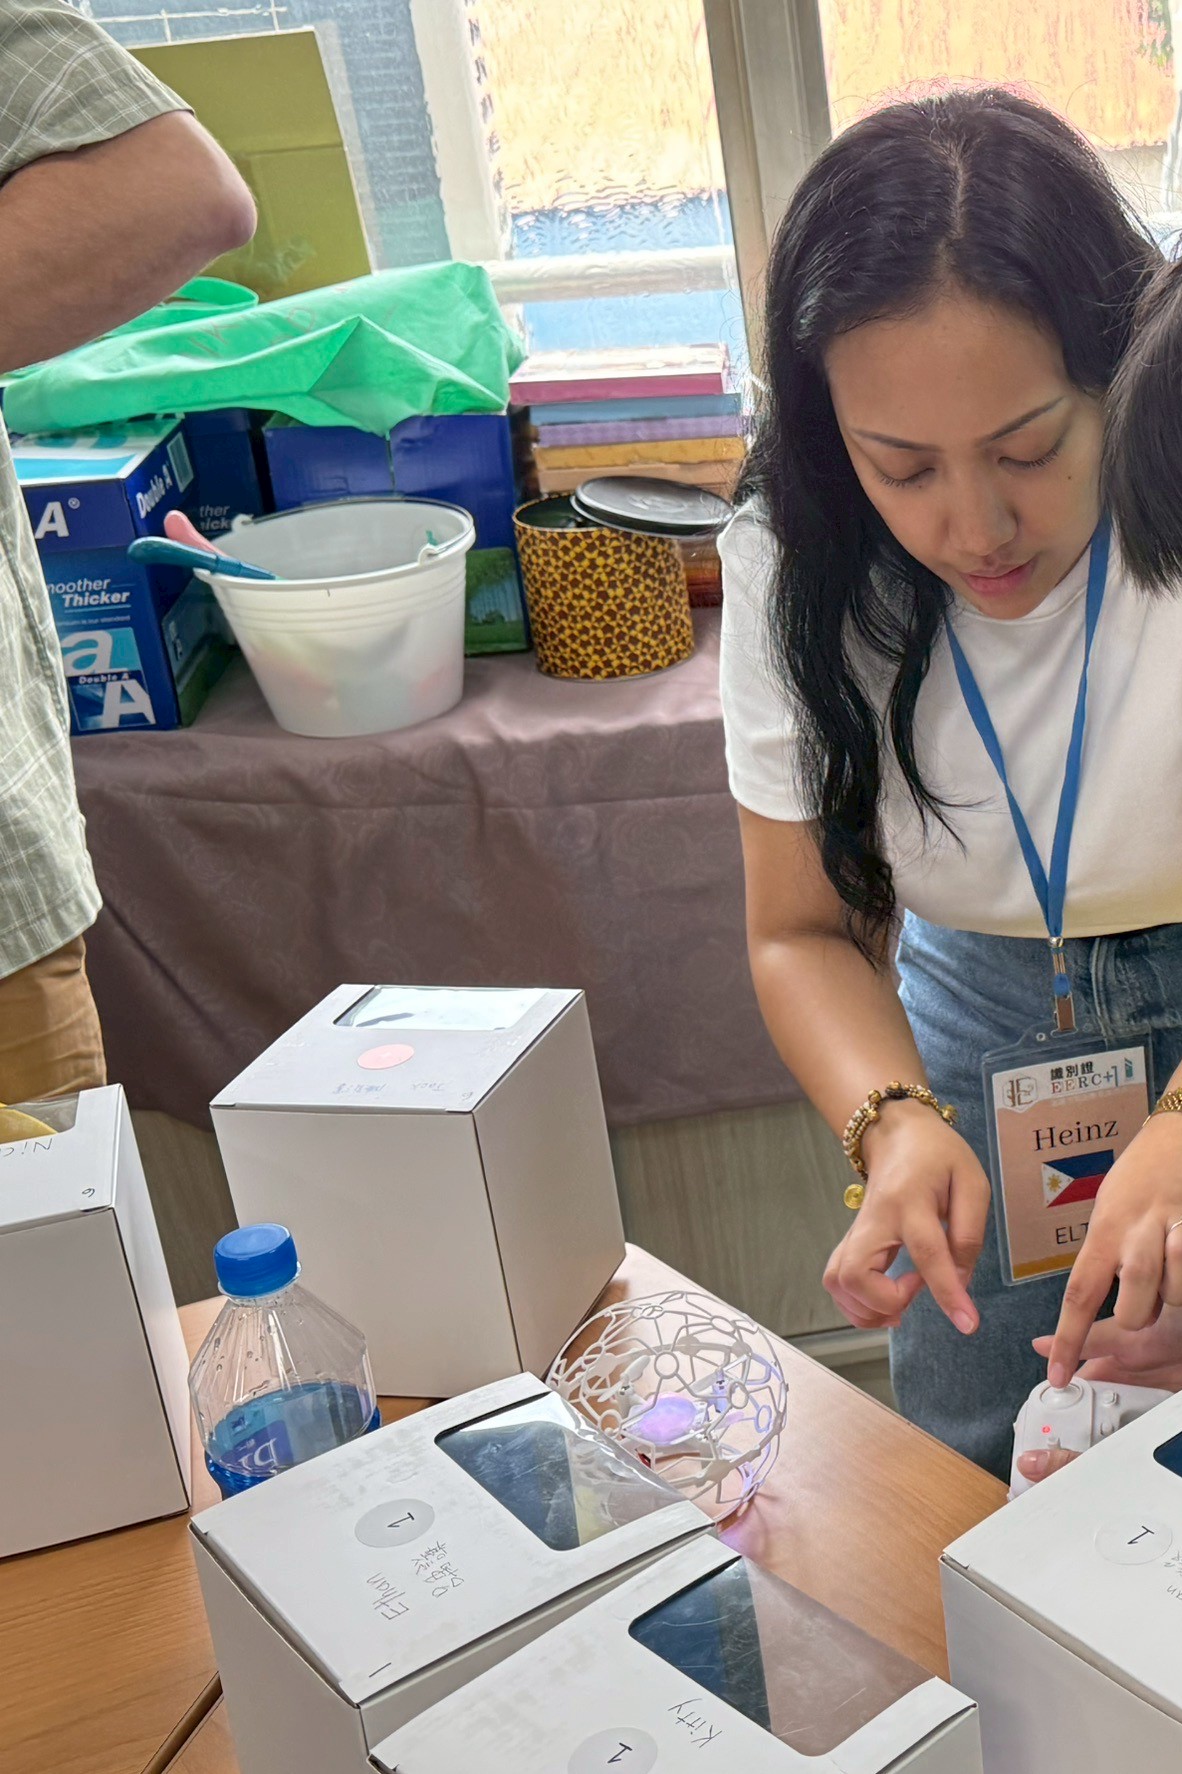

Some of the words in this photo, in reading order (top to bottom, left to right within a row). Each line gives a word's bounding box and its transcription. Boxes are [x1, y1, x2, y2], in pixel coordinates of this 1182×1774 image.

[136, 475, 167, 519] Double
[62, 591, 130, 607] Thicker
[79, 675, 117, 685] Double
[122, 673, 129, 681] A
[101, 680, 157, 728] A
[1050, 1061, 1095, 1081] 識別證
[1033, 1120, 1119, 1152] Heinz
[0, 1138, 53, 1157] Nic
[387, 1512, 415, 1528] 1
[1127, 1525, 1155, 1545] 1
[366, 1572, 410, 1621] Ethan
[667, 1698, 723, 1749] Kitty
[607, 1742, 633, 1764] 1
